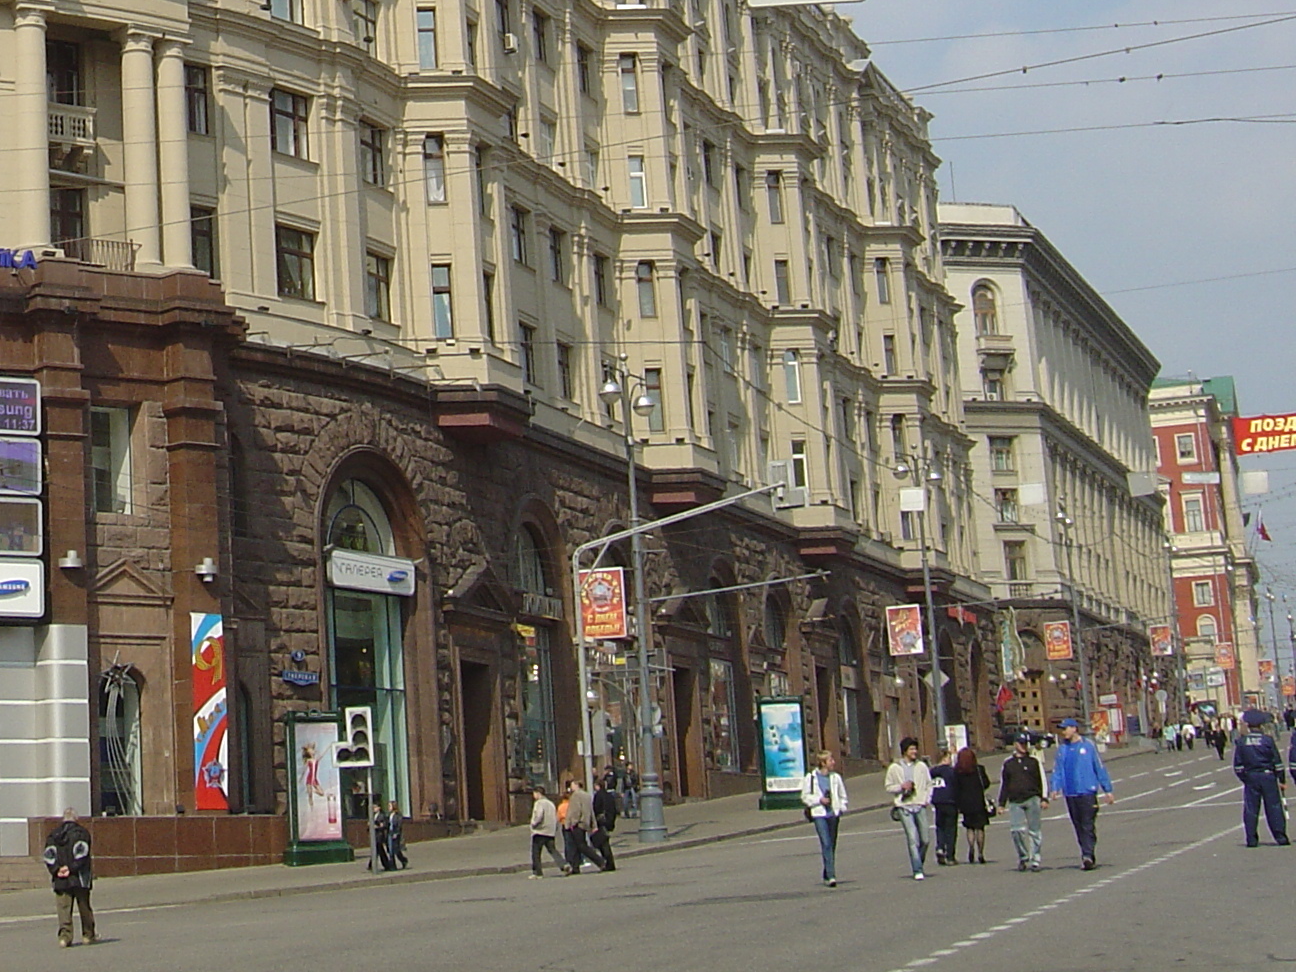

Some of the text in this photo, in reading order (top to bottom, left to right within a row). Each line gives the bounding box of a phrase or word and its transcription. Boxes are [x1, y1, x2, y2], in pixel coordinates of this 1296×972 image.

[4, 419, 35, 430] 11:37
[1241, 438, 1253, 452] С
[339, 562, 383, 579] ГАЛЕРЕЯ
